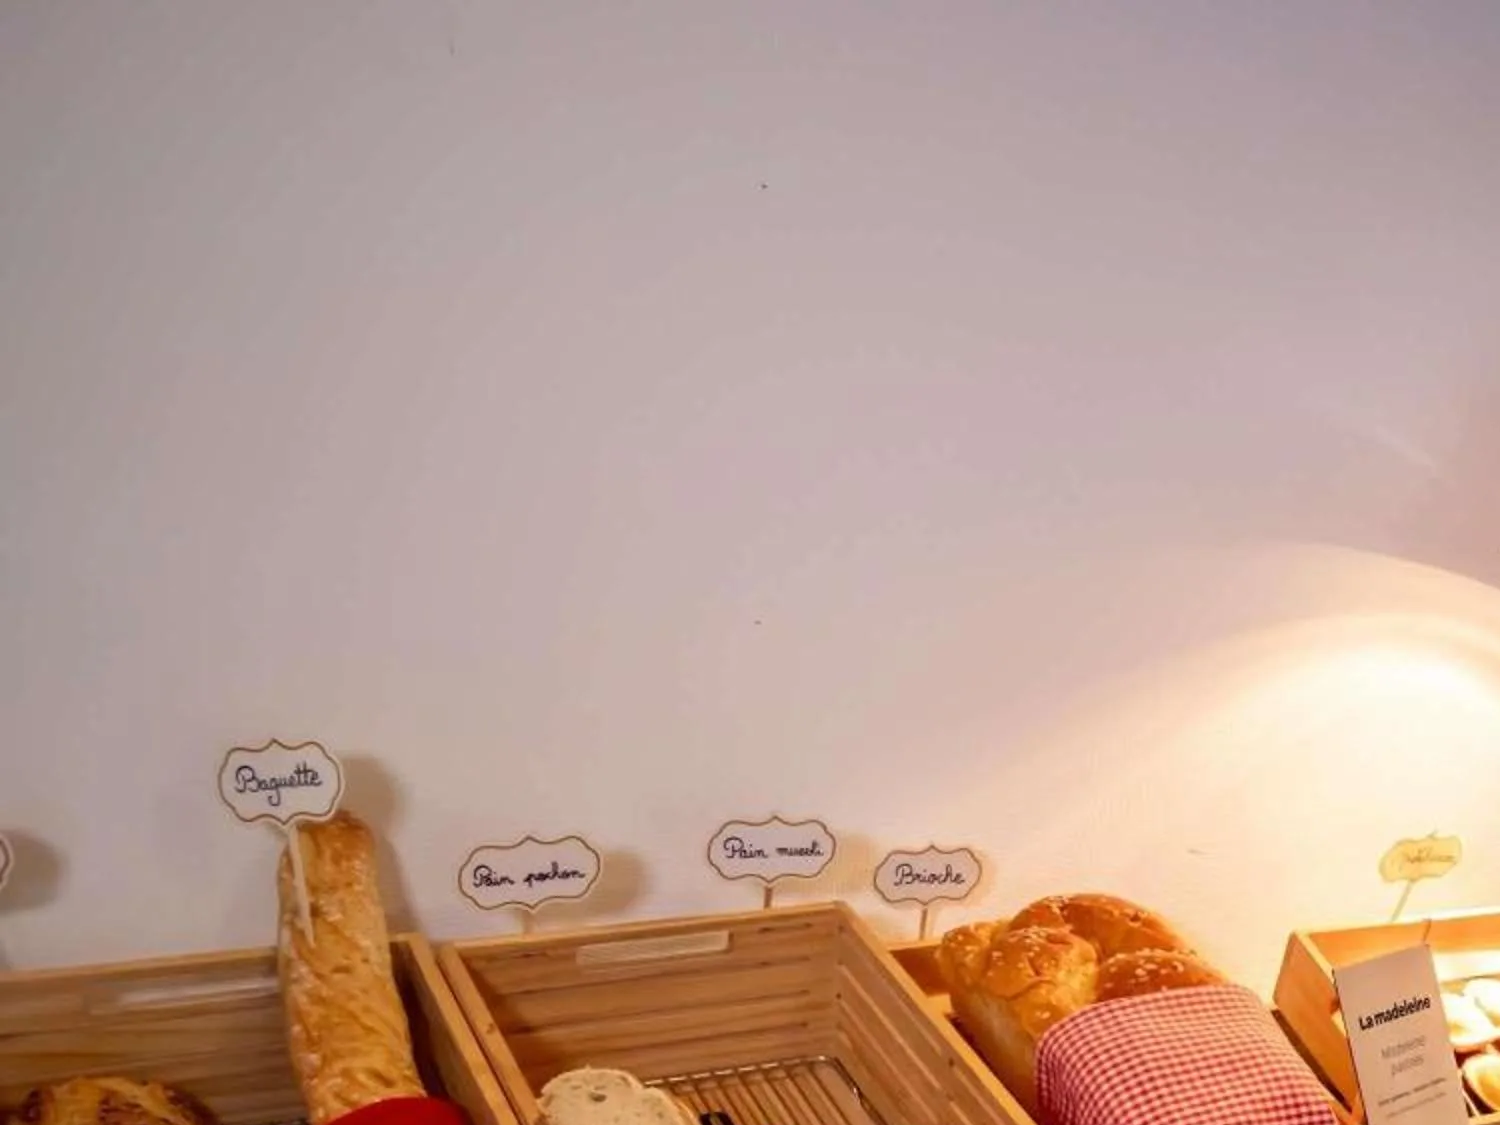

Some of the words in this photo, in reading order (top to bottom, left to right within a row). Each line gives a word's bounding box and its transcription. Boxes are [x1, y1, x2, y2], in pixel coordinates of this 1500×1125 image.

[234, 761, 323, 807] Baguette
[722, 836, 768, 859] Pain
[473, 864, 515, 888] Pain
[893, 863, 966, 887] Brioche
[1358, 1015, 1375, 1031] La
[1374, 997, 1431, 1026] madeleine
